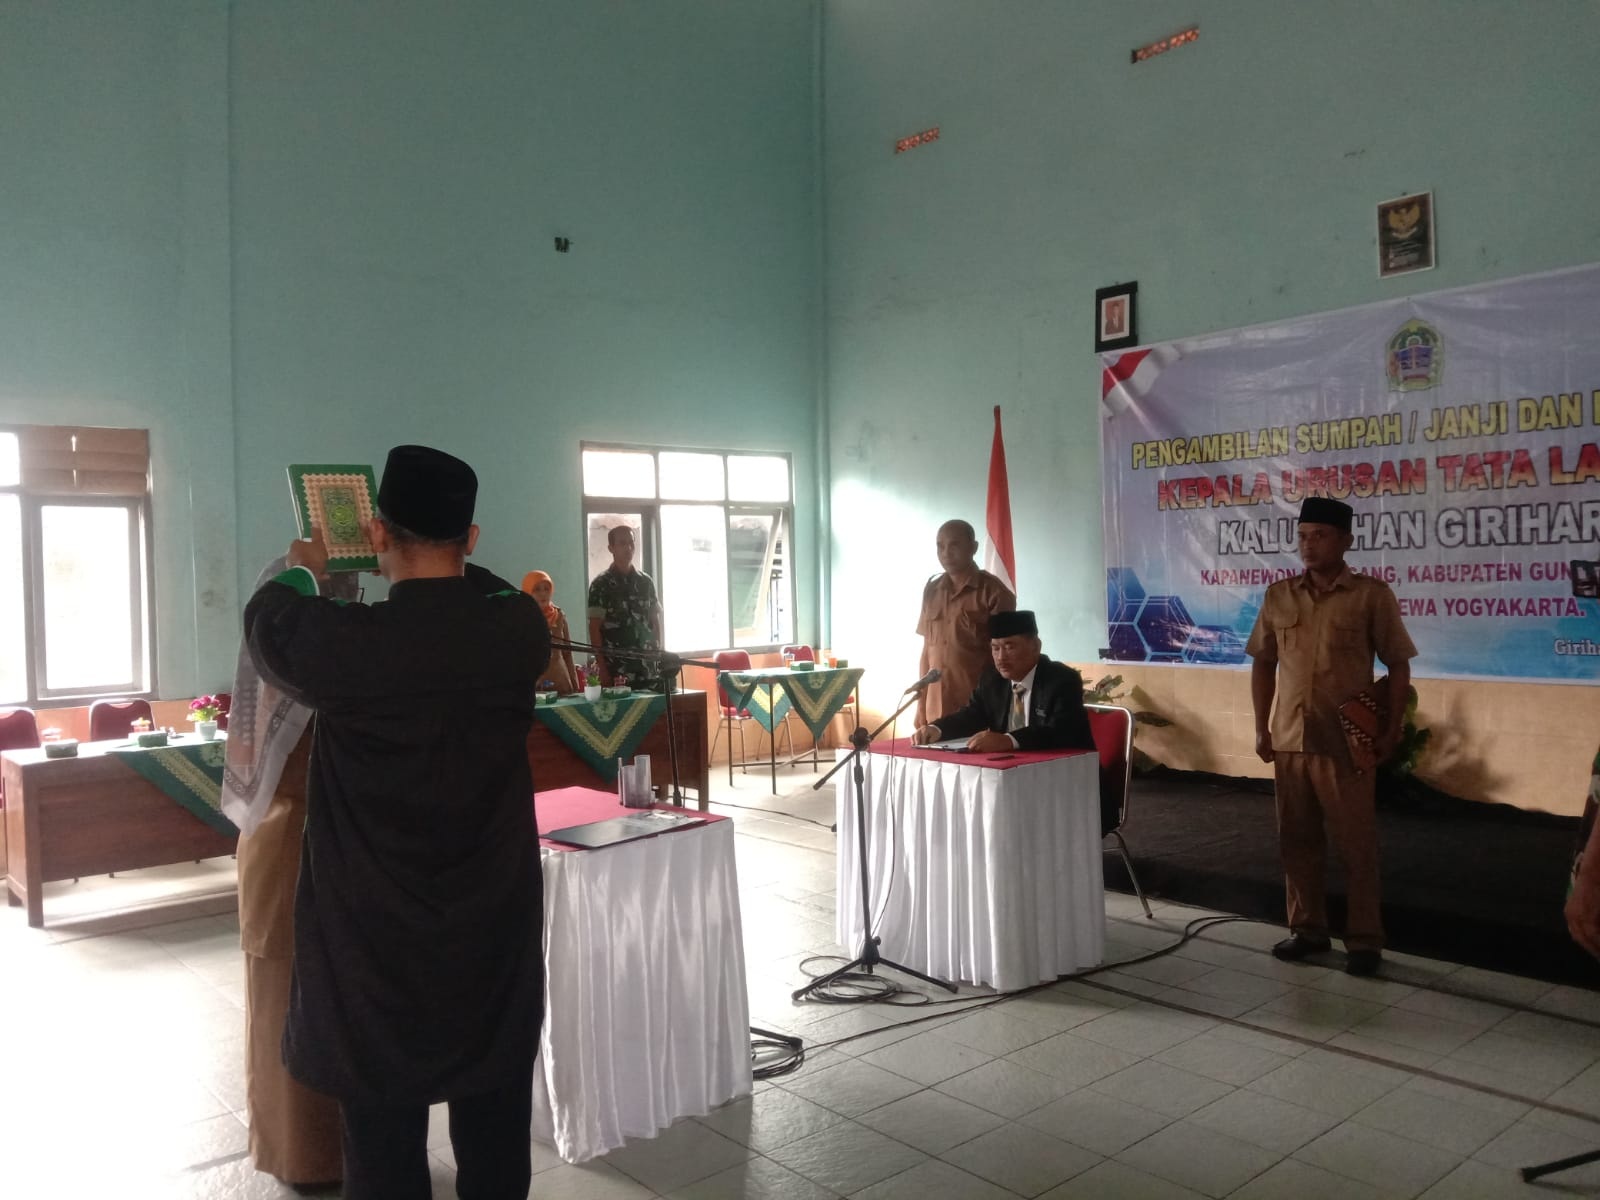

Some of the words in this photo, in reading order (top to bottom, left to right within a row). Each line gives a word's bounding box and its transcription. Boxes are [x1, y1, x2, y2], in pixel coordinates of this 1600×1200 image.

[1132, 426, 1289, 469] PENGAMBILAN
[1296, 412, 1401, 454] SUMPAH
[1408, 410, 1418, 444] /
[1423, 400, 1509, 442] JANJI
[1517, 391, 1583, 432] DAN
[1158, 472, 1274, 511] KEPALA
[1281, 457, 1428, 504] URUSAN
[1436, 449, 1539, 493] TATA
[1219, 511, 1426, 555] KALUHAN
[1408, 563, 1522, 583] KABUPATEN
[1444, 597, 1586, 617] YOGYAKARTA.
[1554, 638, 1600, 656] Girih
